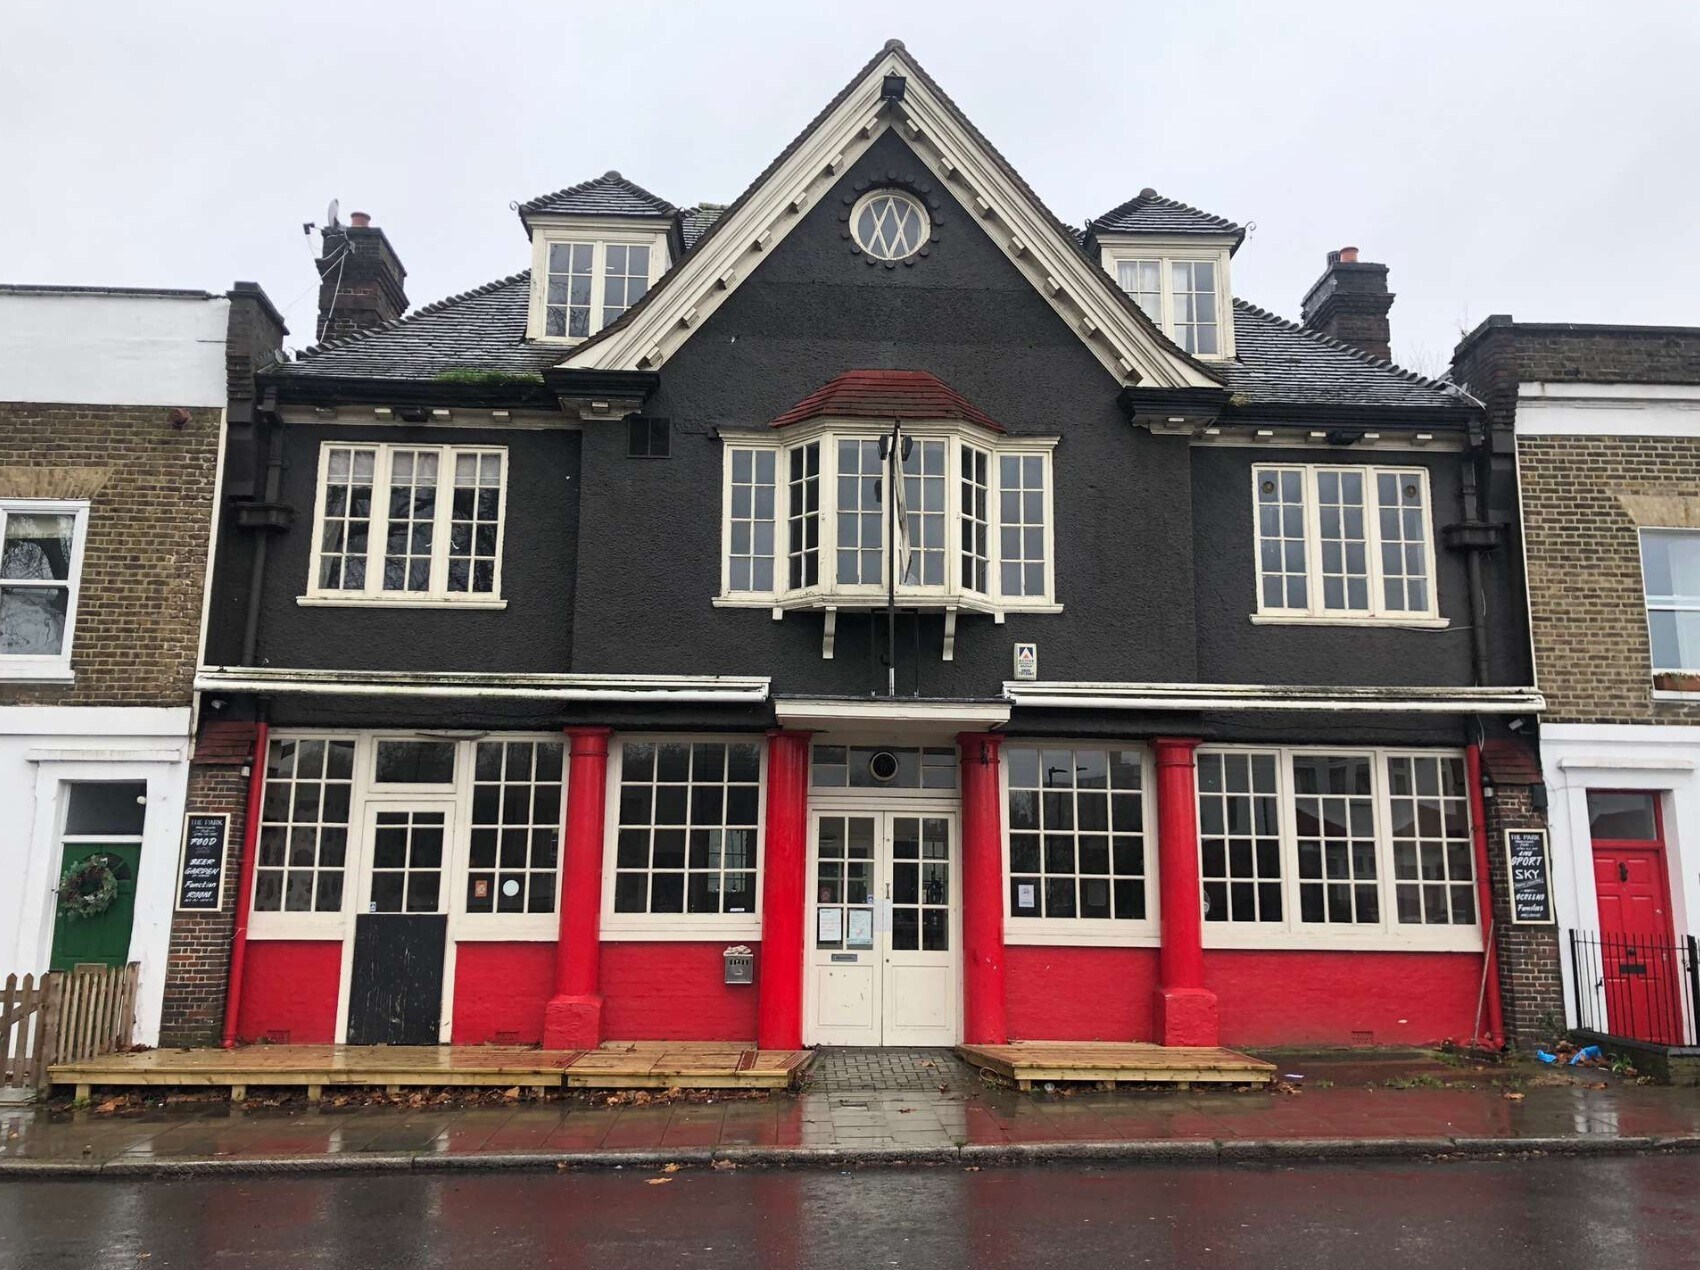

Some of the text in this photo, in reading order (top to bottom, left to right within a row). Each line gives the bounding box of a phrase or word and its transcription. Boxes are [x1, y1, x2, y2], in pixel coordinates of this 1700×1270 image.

[190, 837, 217, 846] FOOD
[1511, 856, 1543, 866] SPORT
[184, 867, 220, 875] GARDEN
[1515, 870, 1540, 880] SKY
[184, 880, 217, 889] Function
[187, 891, 212, 899] ROOM
[1516, 893, 1545, 901] SCREENS
[1517, 903, 1544, 912] Families
